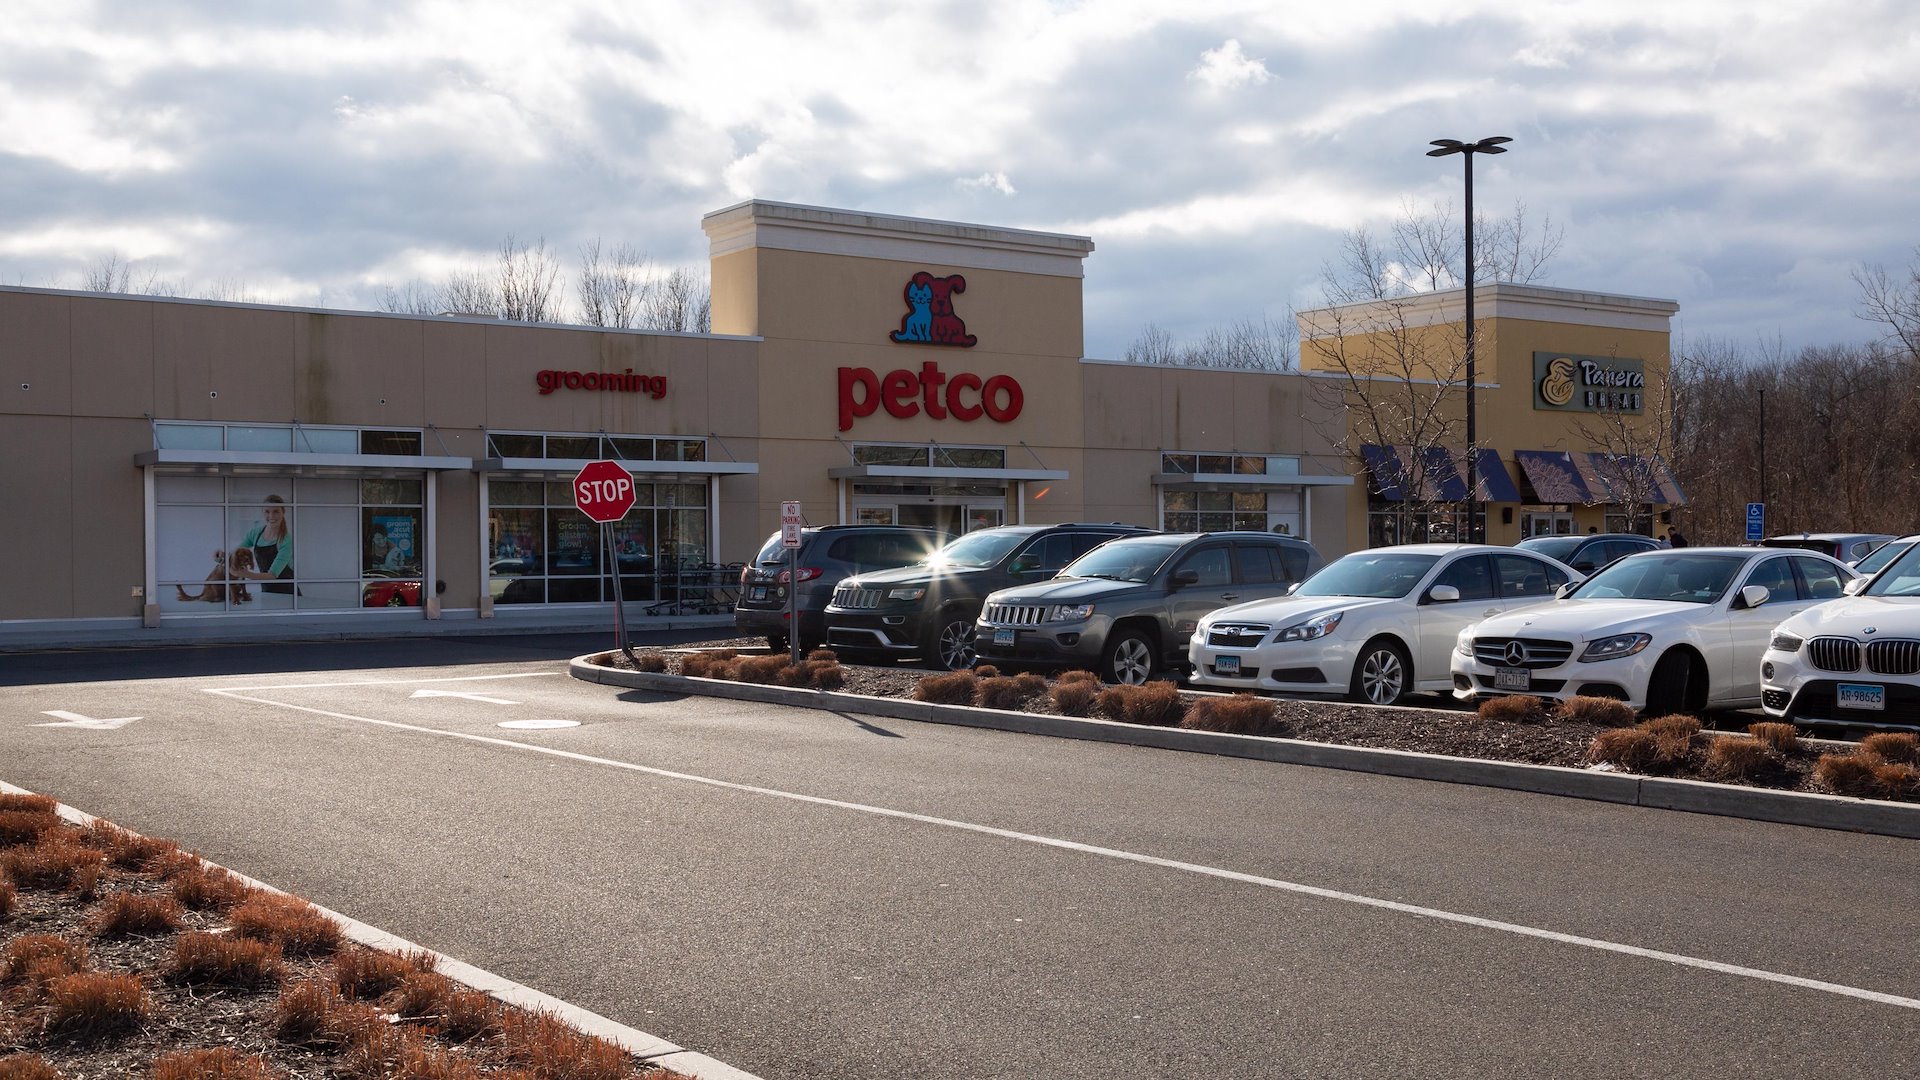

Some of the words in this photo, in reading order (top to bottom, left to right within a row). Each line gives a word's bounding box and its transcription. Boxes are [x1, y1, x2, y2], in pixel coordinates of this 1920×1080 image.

[536, 368, 667, 400] grooming
[1580, 360, 1644, 387] Panera
[838, 361, 1024, 432] petco
[578, 478, 630, 504] STOP
[783, 516, 800, 524] PARKING
[788, 505, 795, 514] NO
